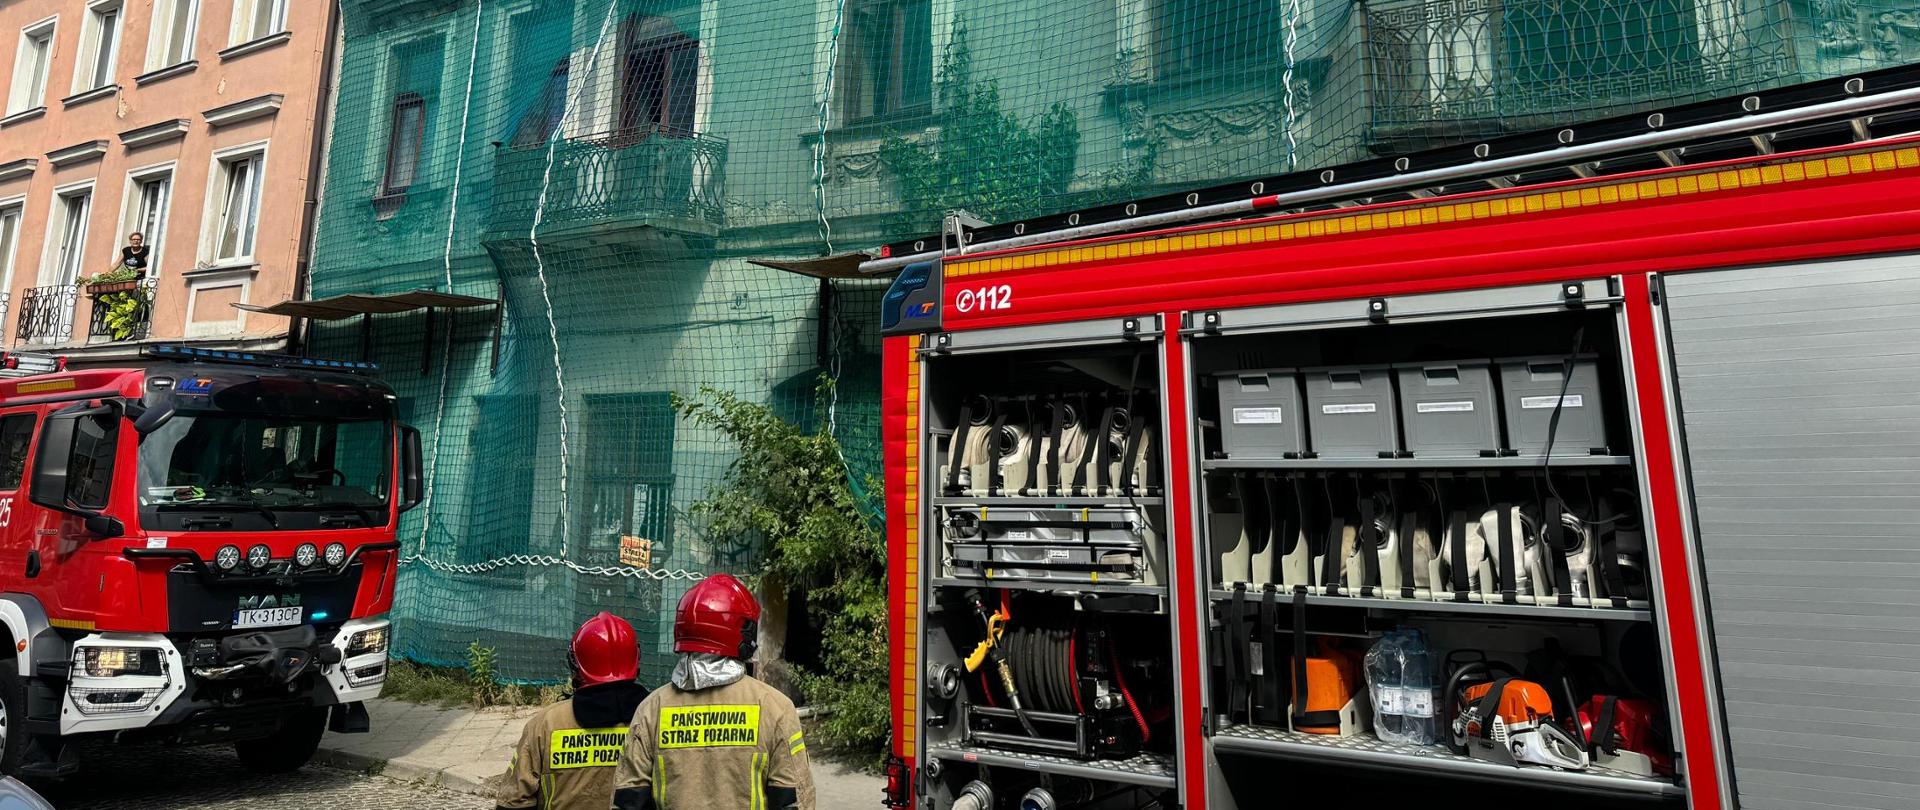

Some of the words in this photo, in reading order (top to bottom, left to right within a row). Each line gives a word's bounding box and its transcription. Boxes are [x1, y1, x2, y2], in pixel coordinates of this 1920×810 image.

[976, 285, 1011, 311] 112
[239, 593, 301, 608] MAN
[242, 610, 257, 625] TK
[262, 607, 299, 622] 313CP
[671, 711, 746, 727] PAŃSTWOWA
[562, 732, 626, 748] PAŃSTWOW
[593, 749, 620, 763] POŻA
